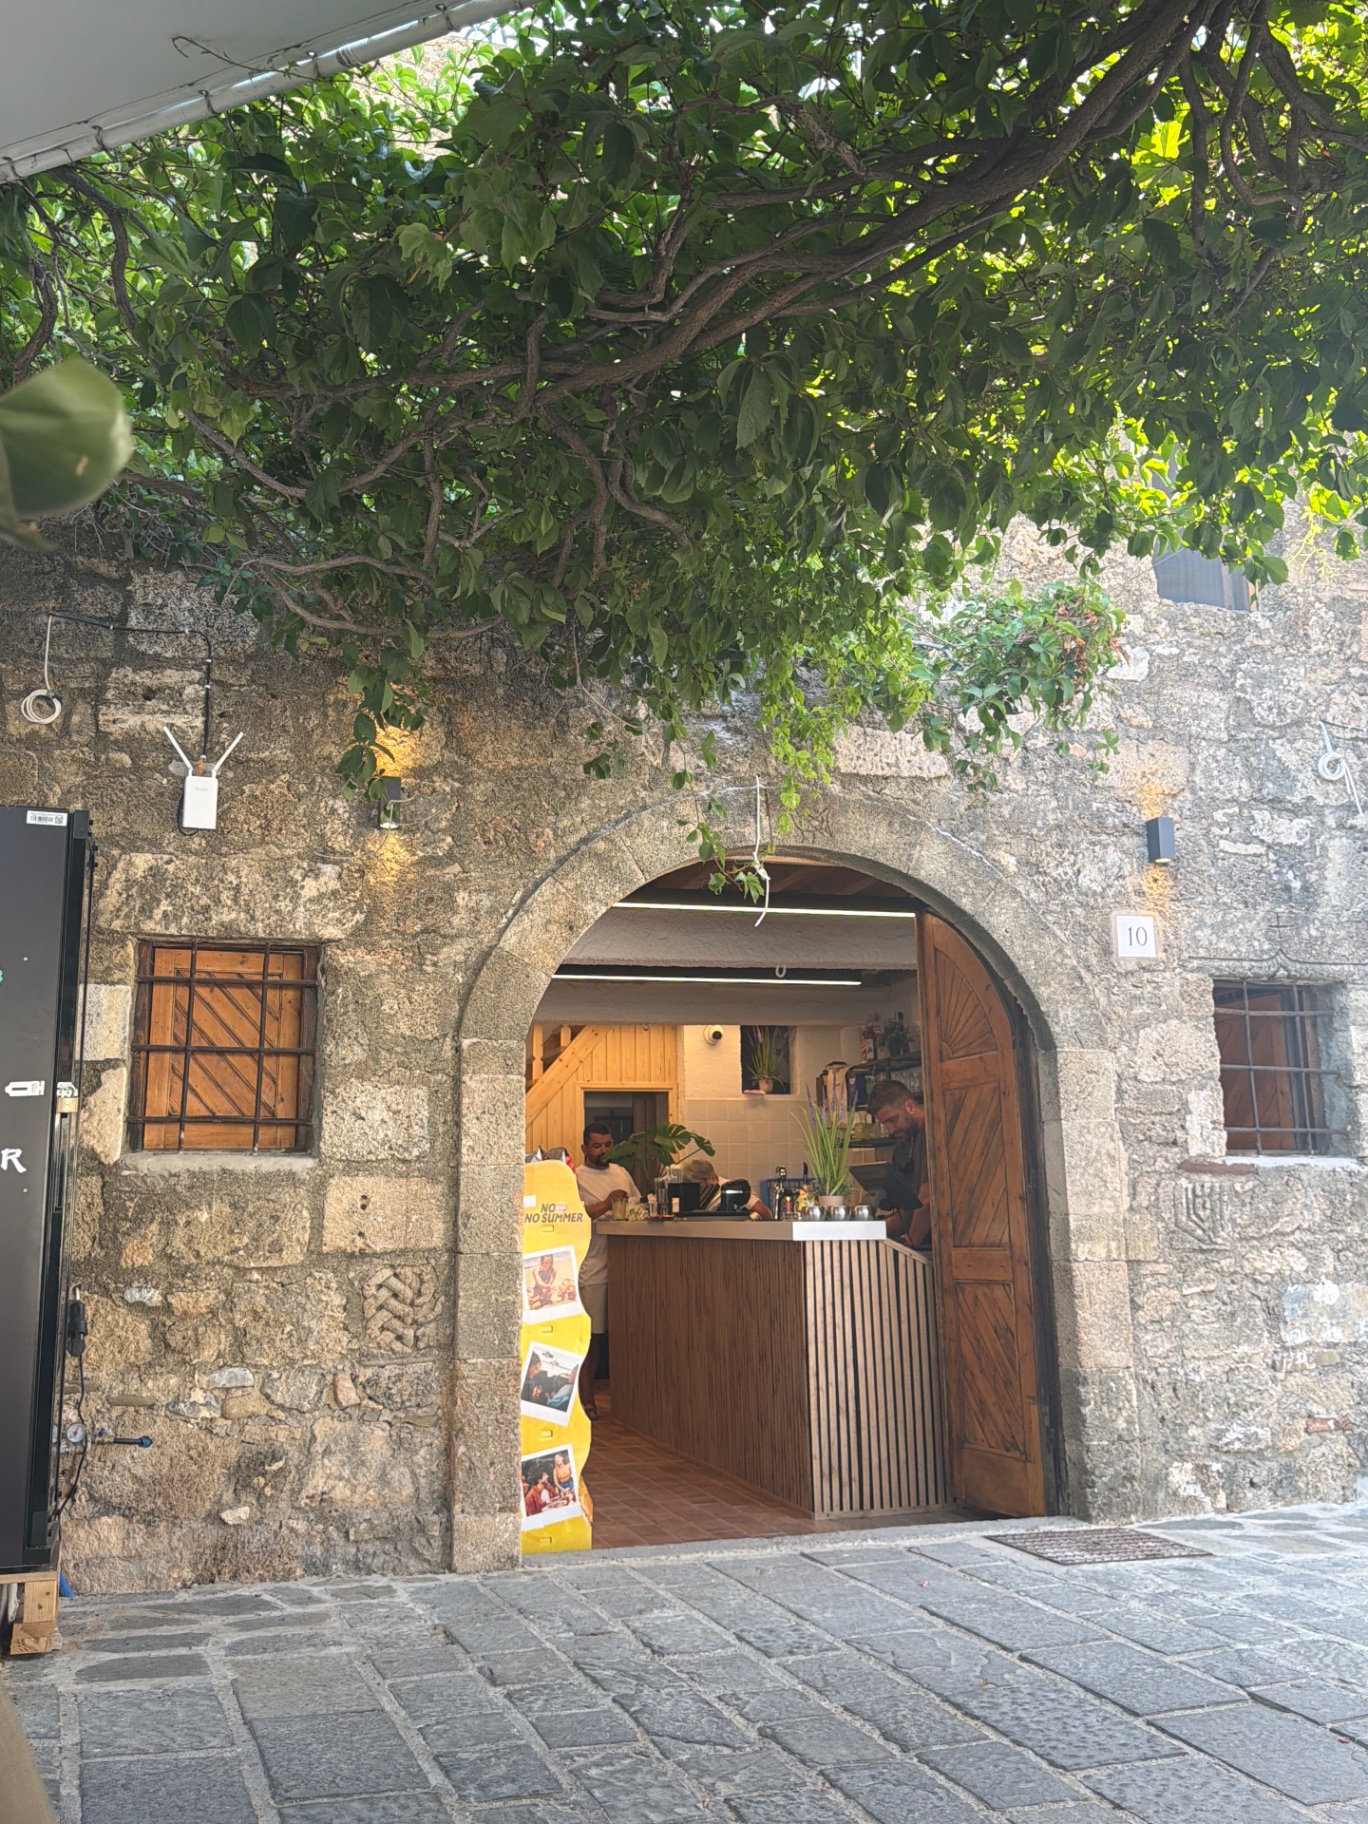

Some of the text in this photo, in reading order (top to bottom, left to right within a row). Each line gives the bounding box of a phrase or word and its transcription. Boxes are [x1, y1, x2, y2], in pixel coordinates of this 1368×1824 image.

[1128, 926, 1148, 947] 10
[0, 1148, 27, 1174] R
[540, 1203, 556, 1213] NO
[524, 1212, 583, 1223] NO SUMMER
